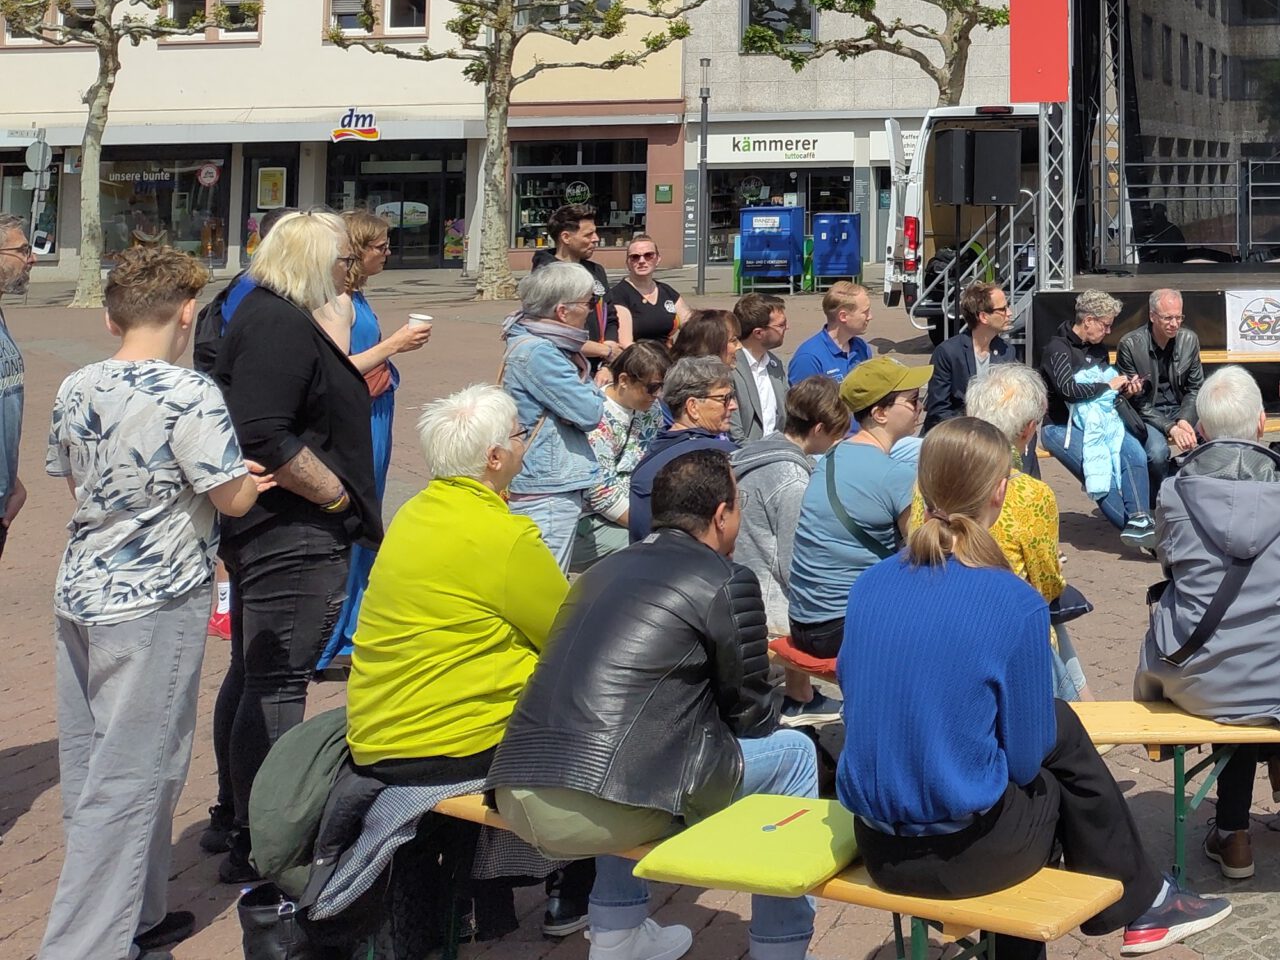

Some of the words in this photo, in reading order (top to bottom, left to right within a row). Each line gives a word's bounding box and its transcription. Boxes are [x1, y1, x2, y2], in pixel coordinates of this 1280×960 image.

[340, 108, 374, 128] dm
[732, 136, 819, 152] kämmerer
[108, 171, 141, 181] unsere
[142, 170, 171, 181] bunte
